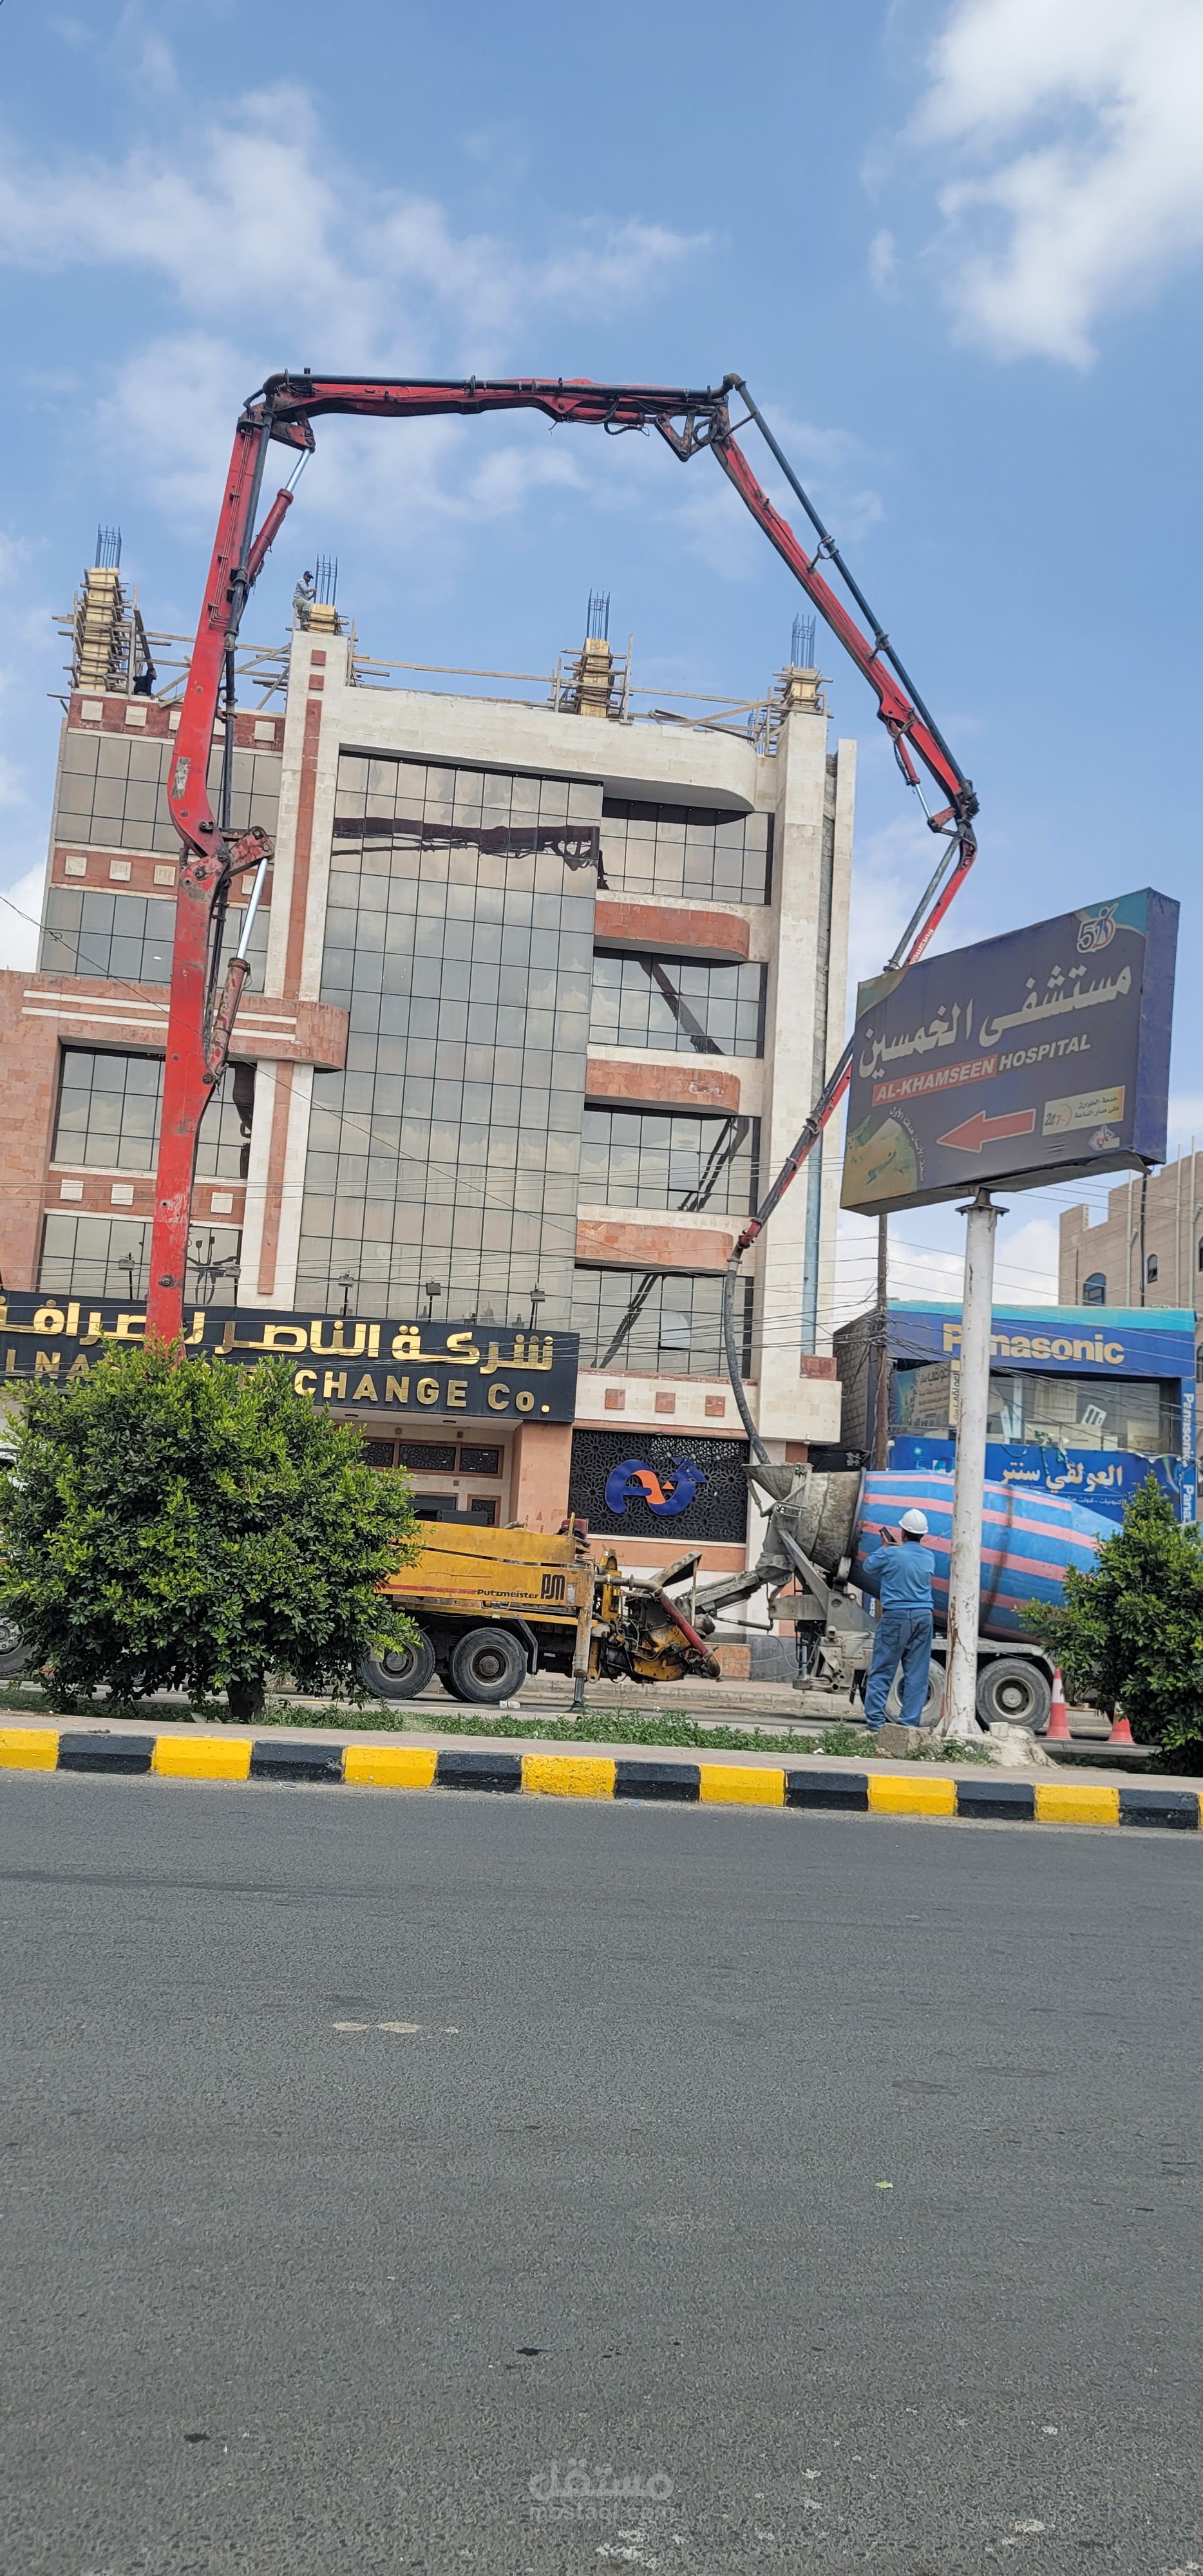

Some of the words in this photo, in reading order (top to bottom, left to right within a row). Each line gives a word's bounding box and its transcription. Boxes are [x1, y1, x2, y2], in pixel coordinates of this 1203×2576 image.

[979, 965, 1132, 1047] مستشفى
[859, 999, 973, 1079] الخمسين
[876, 1058, 995, 1101] AL-KHAMSEEN
[999, 1034, 1091, 1071] HOSPITAL
[1108, 1105, 1119, 1113] على
[214, 1320, 380, 1358] الناصر
[392, 1325, 553, 1374] شركة
[943, 1323, 1124, 1364] Pnasonic
[488, 1383, 550, 1413] Co.
[999, 1461, 1041, 1484] سنتر
[1046, 1462, 1122, 1493] العولقي
[477, 1589, 540, 1599] Putzmeister
